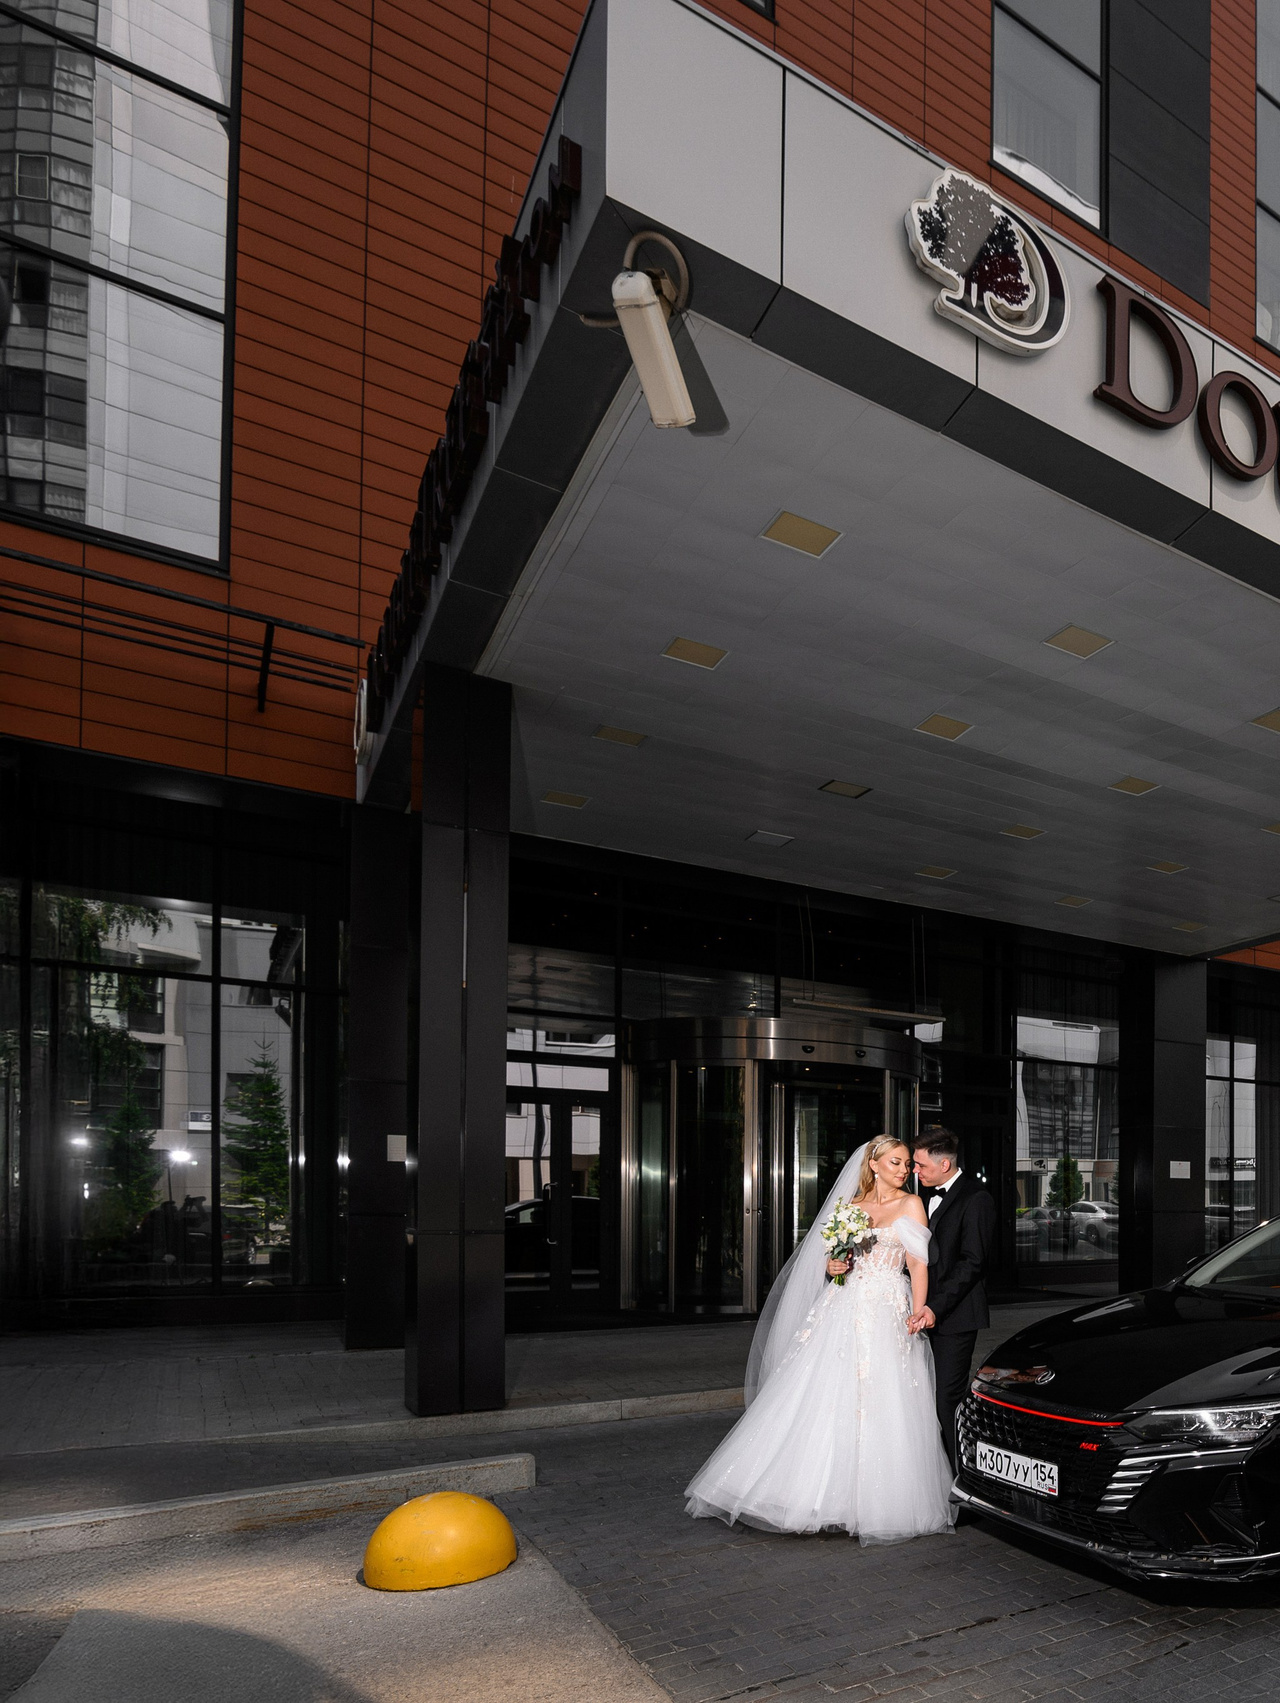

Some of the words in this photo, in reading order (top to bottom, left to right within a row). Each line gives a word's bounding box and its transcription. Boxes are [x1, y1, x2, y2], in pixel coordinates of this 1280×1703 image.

[1080, 1442, 1100, 1452] MAX
[1033, 1462, 1055, 1485] 154
[1037, 1481, 1049, 1491] RUS
